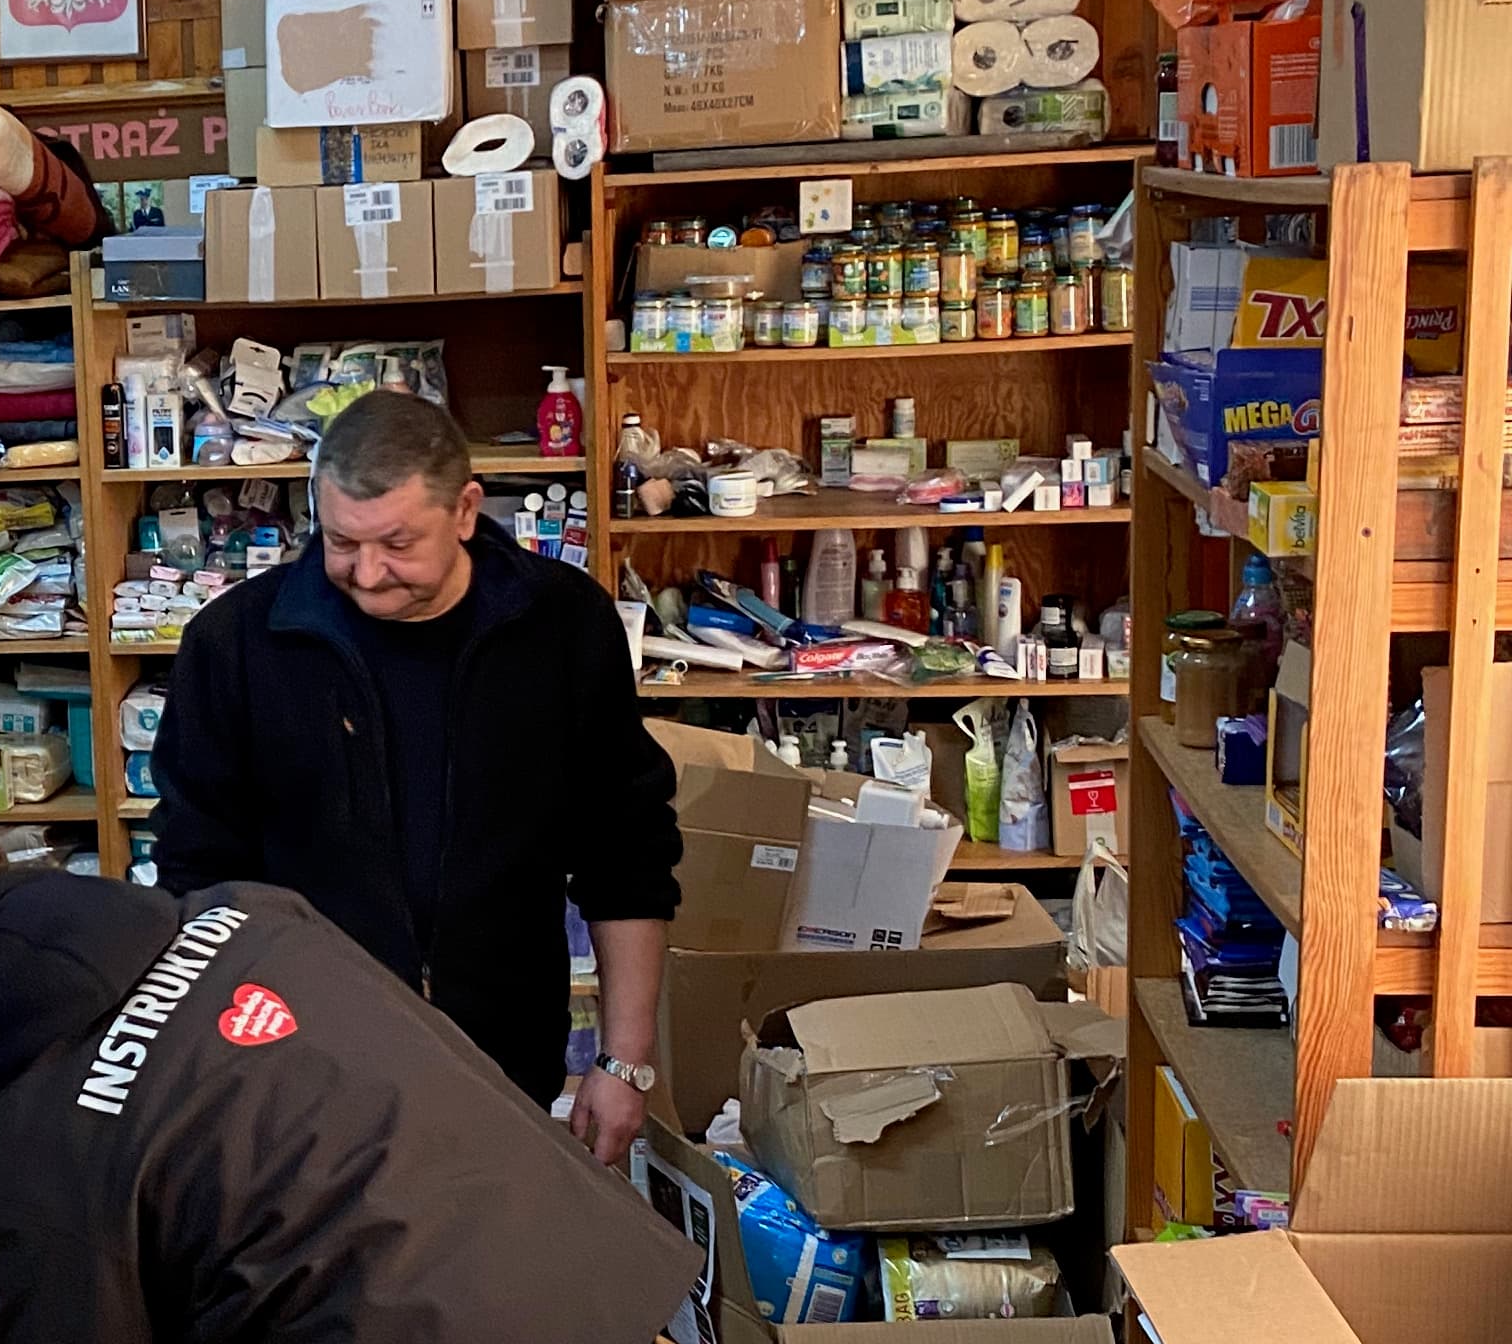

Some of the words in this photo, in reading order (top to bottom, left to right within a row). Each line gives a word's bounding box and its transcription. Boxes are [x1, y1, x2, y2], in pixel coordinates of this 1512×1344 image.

[36, 108, 180, 160] TRAŻ
[1250, 291, 1327, 340] XL
[1224, 400, 1294, 434] MEGA
[799, 651, 846, 664] Colgate
[77, 905, 250, 1116] INSTRUKTOR
